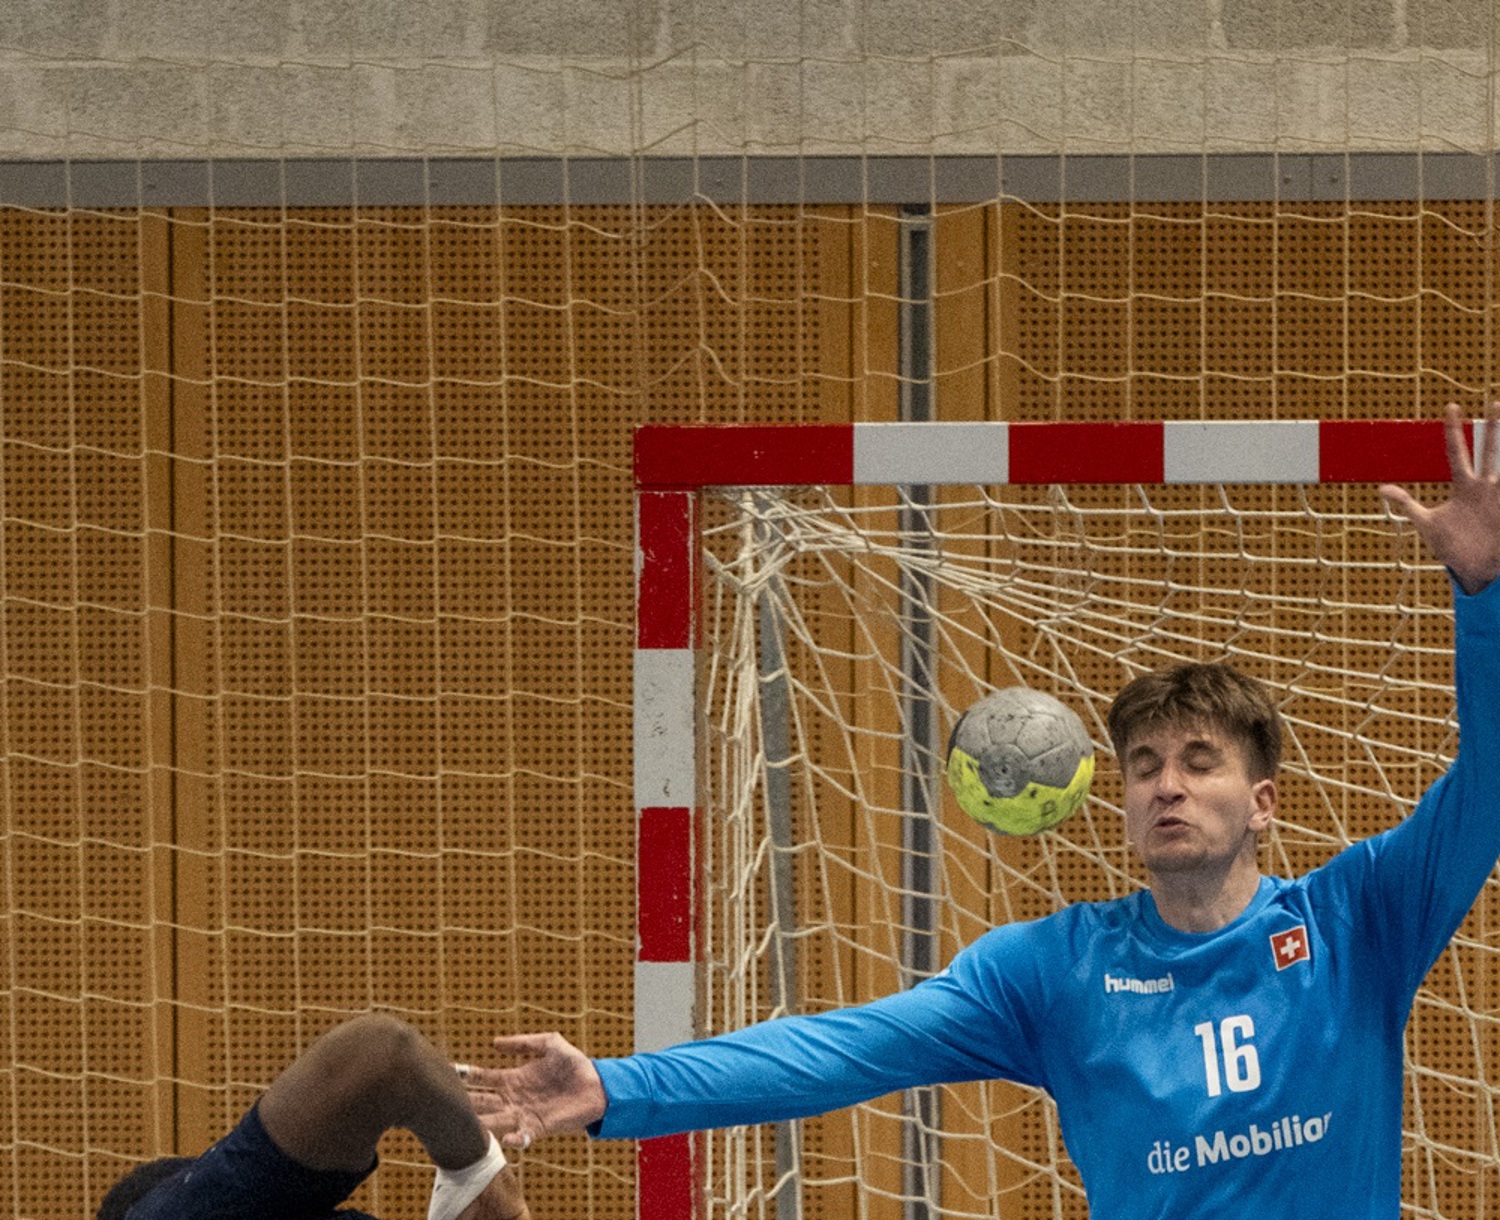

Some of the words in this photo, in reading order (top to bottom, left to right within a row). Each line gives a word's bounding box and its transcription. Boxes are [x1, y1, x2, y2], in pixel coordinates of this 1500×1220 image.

[1104, 972, 1175, 994] hummel
[1194, 1014, 1261, 1097] 16
[1147, 1141, 1190, 1174] die
